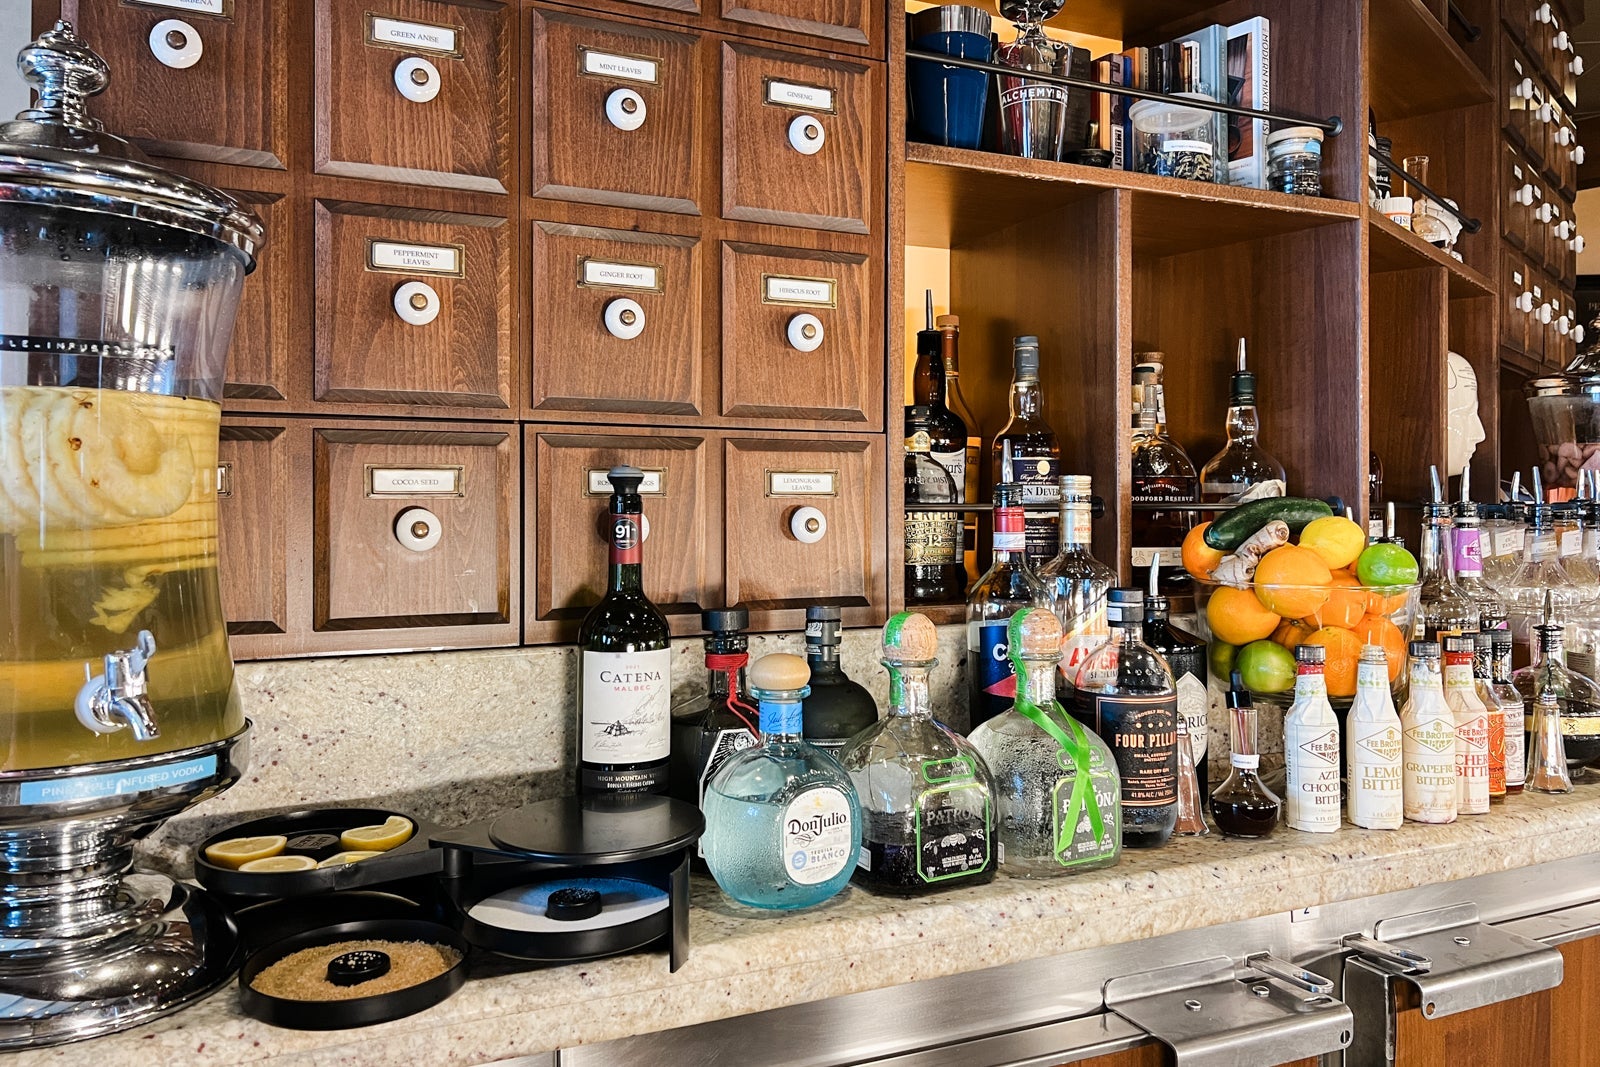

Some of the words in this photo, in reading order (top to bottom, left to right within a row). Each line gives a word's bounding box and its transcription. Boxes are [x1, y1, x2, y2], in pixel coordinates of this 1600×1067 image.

[390, 29, 416, 39] GREEN
[417, 34, 439, 43] ANISE
[599, 63, 616, 71] MINT
[617, 65, 642, 75] LEAVES
[786, 91, 813, 101] GINSENG
[1002, 88, 1053, 104] ALCHEMY
[393, 249, 440, 259] PEPPERMINT
[402, 258, 431, 266] LEAVES
[626, 272, 643, 280] ROOT
[615, 525, 631, 538] 91
[926, 535, 942, 546] 12
[599, 670, 661, 683] CATENA
[1412, 730, 1425, 738] FEE
[1458, 728, 1471, 736] FEE
[1115, 733, 1145, 748] FOUR
[1366, 739, 1379, 747] FEE
[1310, 743, 1322, 751] FEE
[171, 764, 204, 779] VODKA
[615, 774, 648, 782] MOUNTAIN
[1416, 776, 1455, 785] BITTERS
[811, 847, 833, 855] TEQUILA
[811, 849, 845, 863] BLANCO
